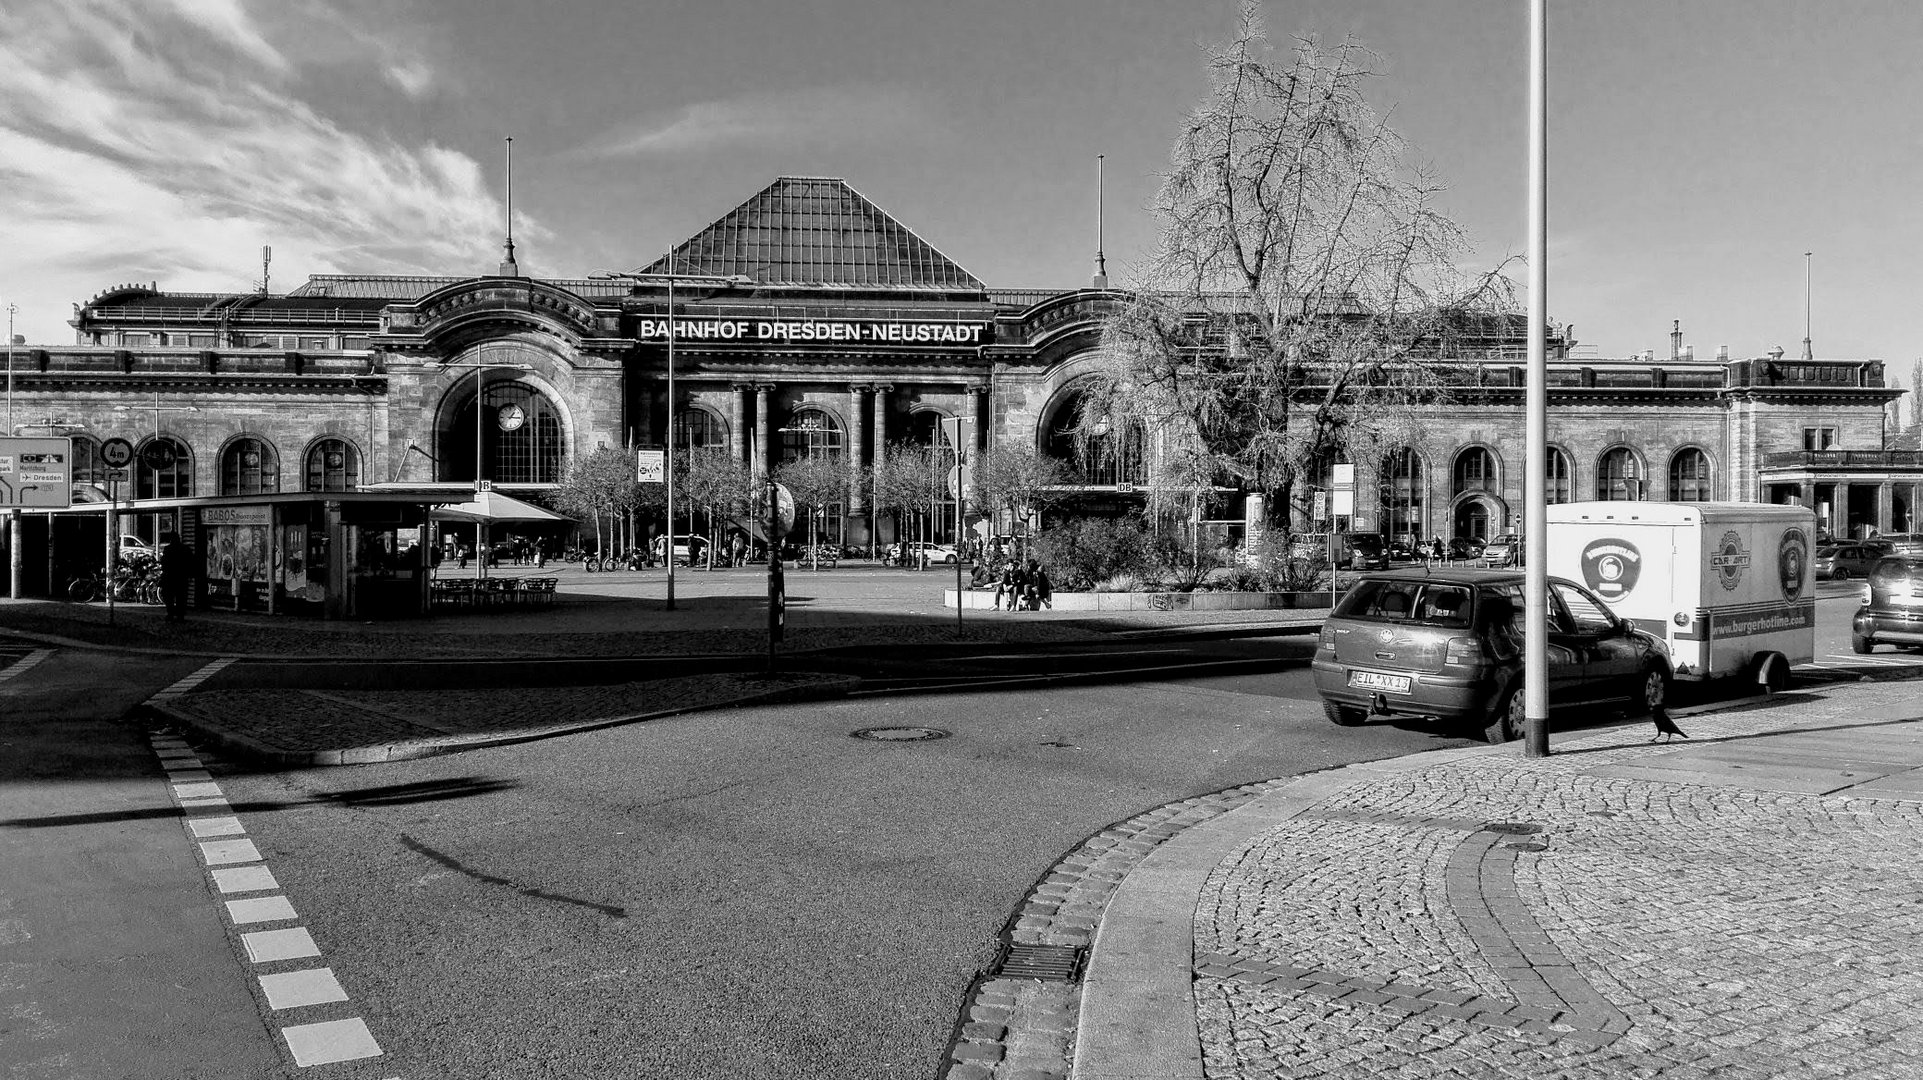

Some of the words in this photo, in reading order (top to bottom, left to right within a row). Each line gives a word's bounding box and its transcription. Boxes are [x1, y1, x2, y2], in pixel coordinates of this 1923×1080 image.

[640, 319, 750, 340] BAHNHOF
[757, 321, 984, 342] DRESDEN-NEUSTADT
[109, 446, 125, 459] 4m
[1119, 484, 1132, 492] DB
[1713, 556, 1729, 565] CAR
[1713, 615, 1806, 636] www.burgerhotline.com
[1357, 673, 1375, 685] EIL
